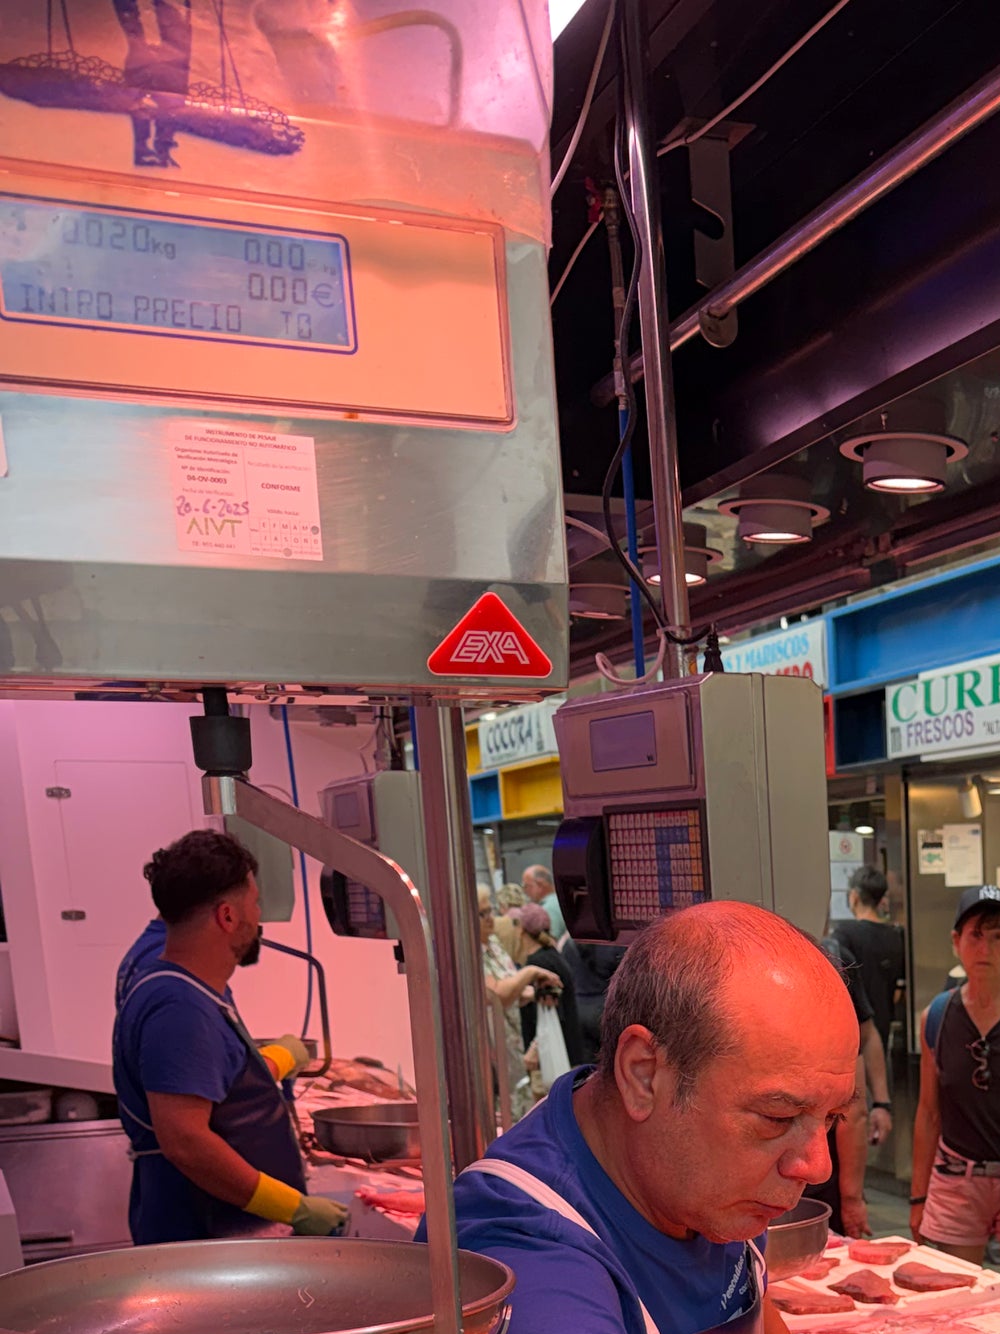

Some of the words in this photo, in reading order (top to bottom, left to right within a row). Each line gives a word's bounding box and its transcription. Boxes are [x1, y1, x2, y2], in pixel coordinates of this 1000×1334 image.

[20, 283, 113, 321] INTRO
[134, 295, 242, 333] PRECIO
[261, 482, 301, 492] CONFORME
[450, 630, 530, 665] EXA
[906, 711, 974, 748] FRESCOS
